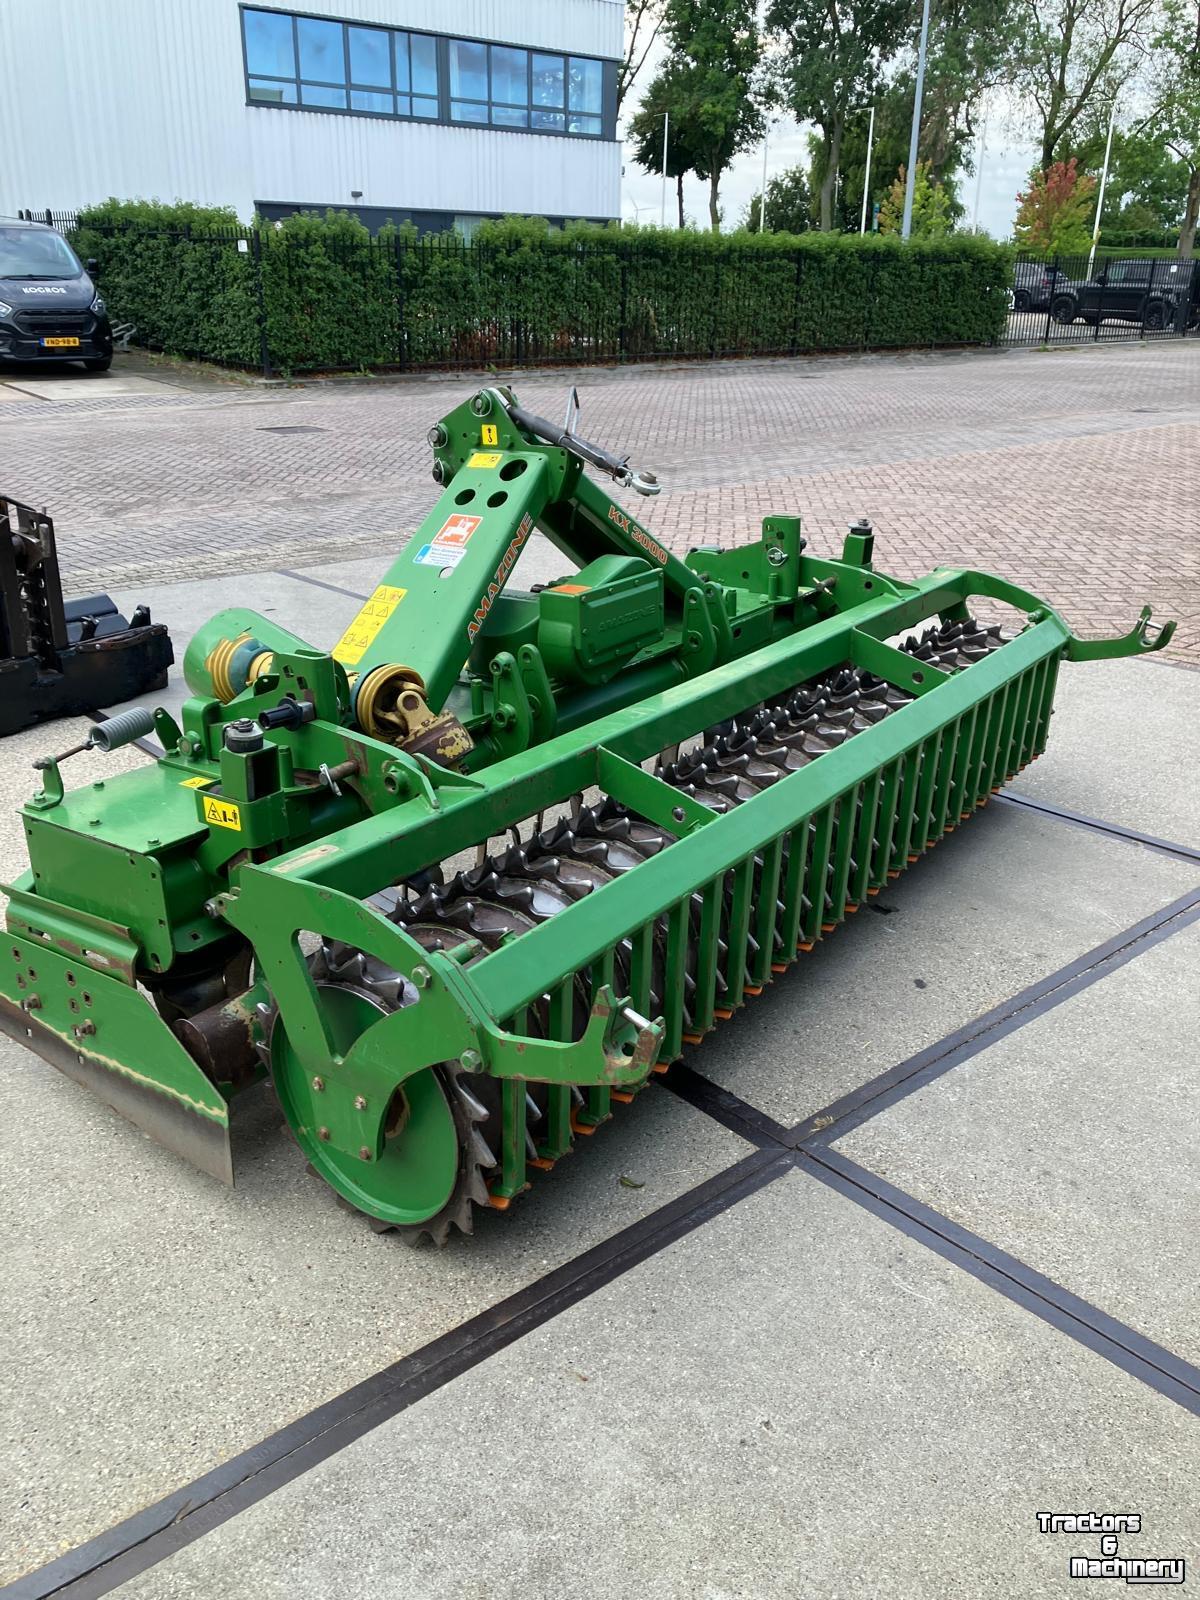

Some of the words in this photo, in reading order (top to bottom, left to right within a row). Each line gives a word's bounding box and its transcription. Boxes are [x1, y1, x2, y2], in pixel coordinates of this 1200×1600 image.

[22, 286, 67, 294] KOGROS
[608, 505, 631, 533] KX
[631, 525, 668, 565] 3000
[468, 511, 533, 645] AMAZONE
